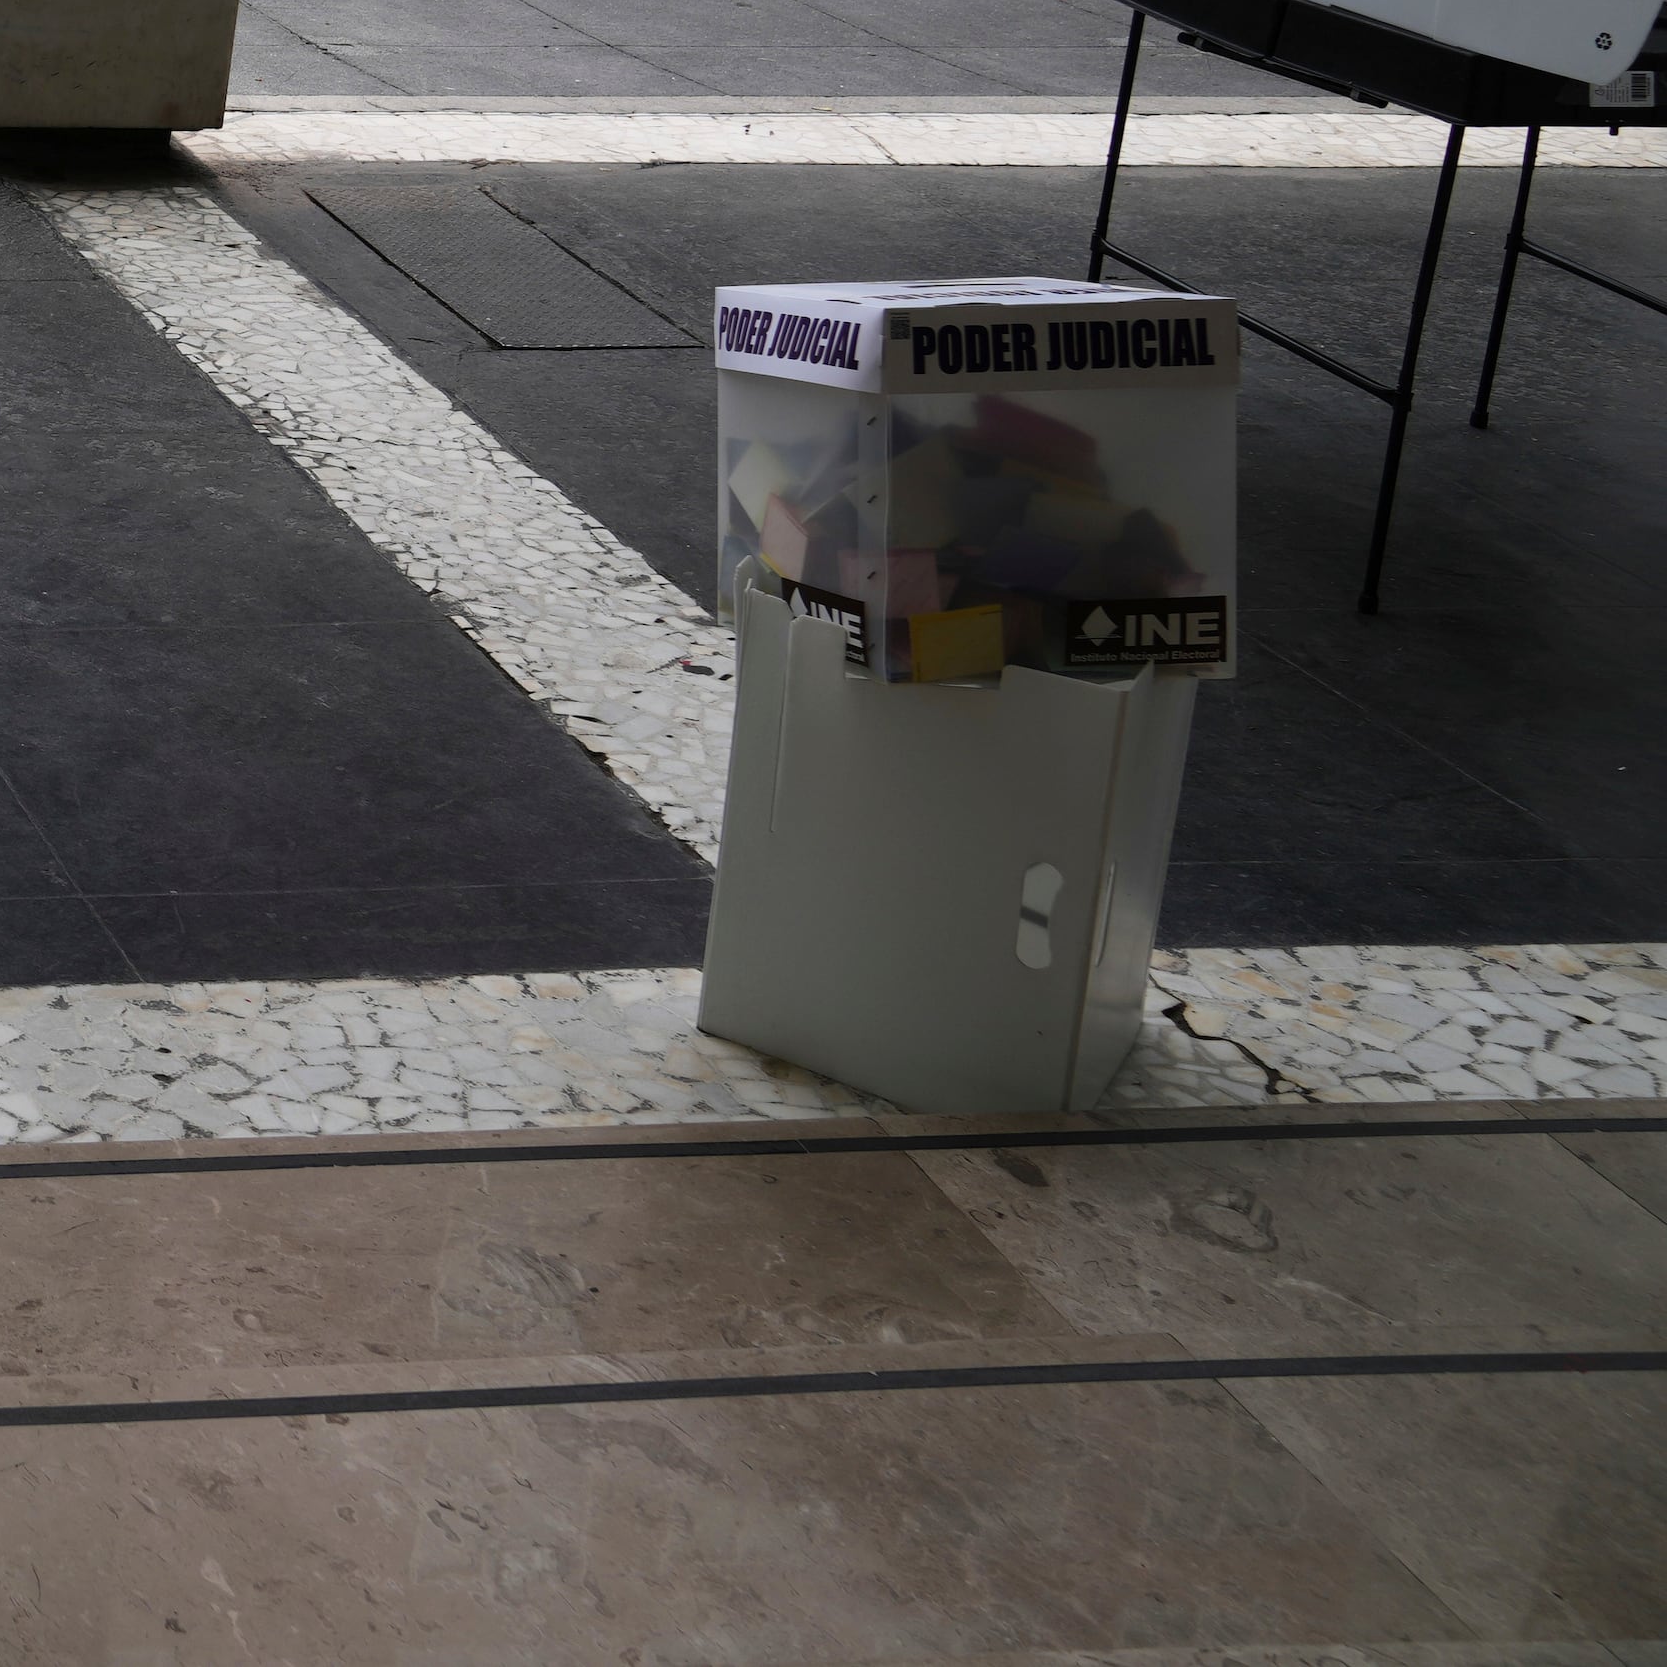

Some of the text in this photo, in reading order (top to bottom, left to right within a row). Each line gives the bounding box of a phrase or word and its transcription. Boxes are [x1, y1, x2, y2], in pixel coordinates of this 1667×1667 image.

[719, 306, 862, 371] PODER JUDICIAL
[912, 317, 1216, 375] PODER JUDICIAL
[1124, 611, 1220, 647] INE
[1069, 648, 1220, 663] Instituto Nacional Electoral
